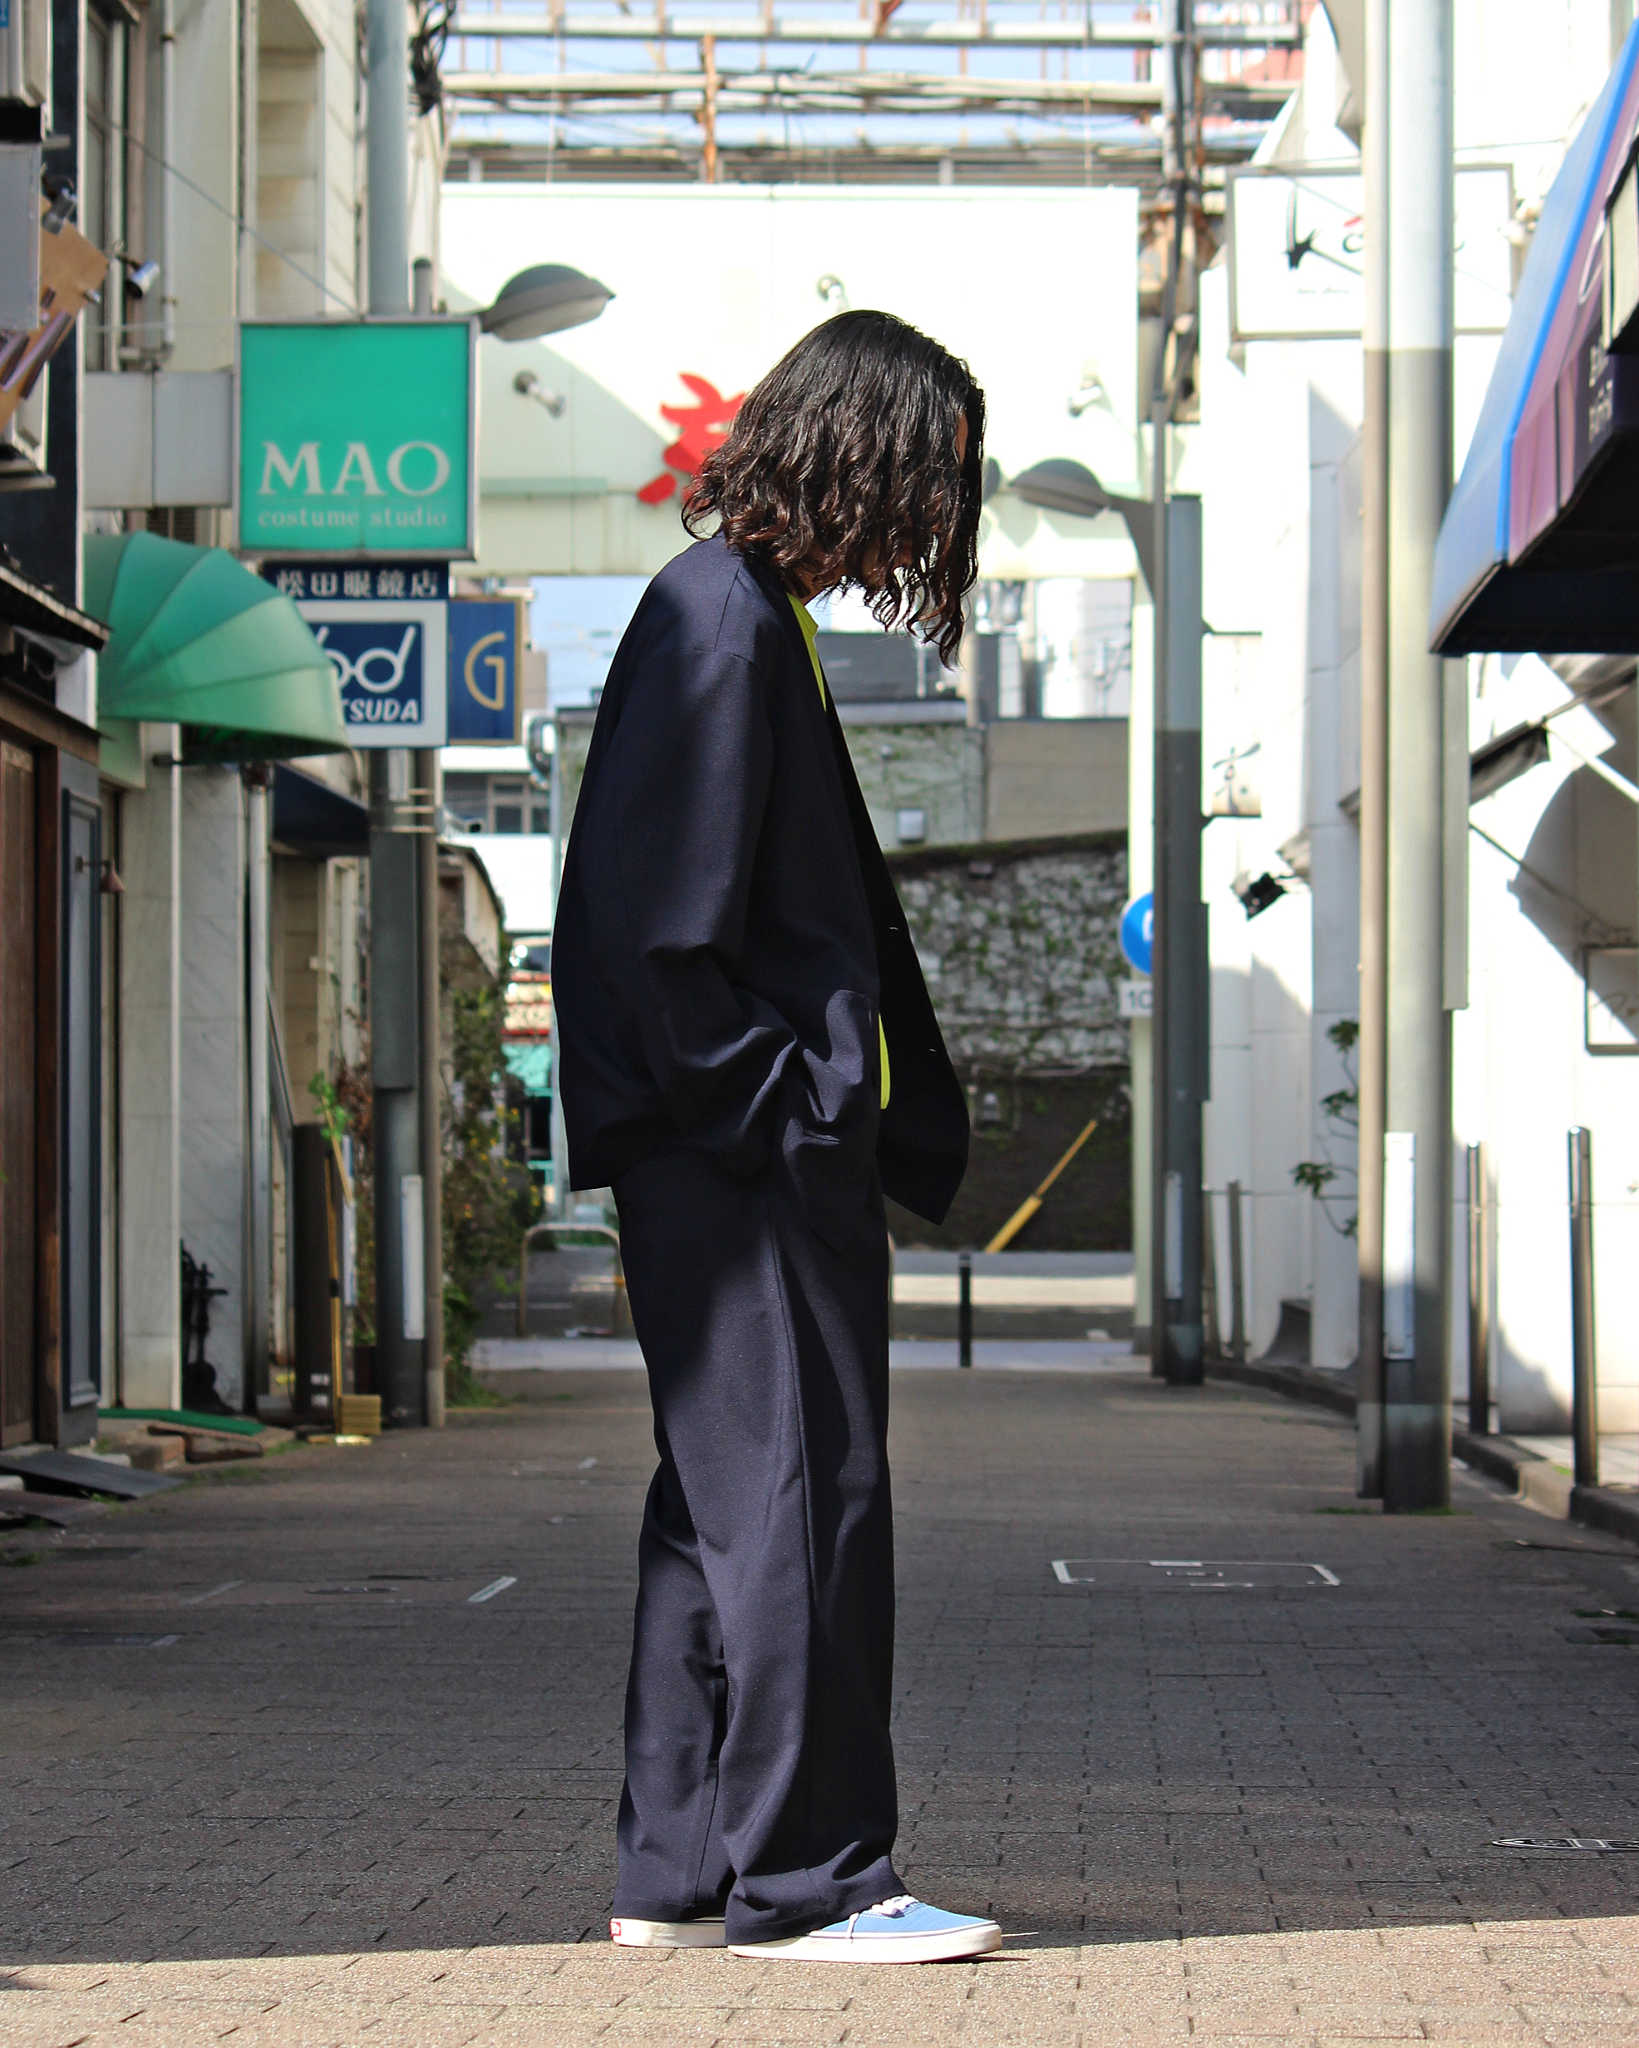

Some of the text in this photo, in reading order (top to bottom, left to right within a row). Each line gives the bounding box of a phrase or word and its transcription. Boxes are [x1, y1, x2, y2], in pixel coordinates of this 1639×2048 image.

[257, 440, 451, 497] MAO
[258, 504, 447, 528] costume studio
[463, 631, 506, 711] G
